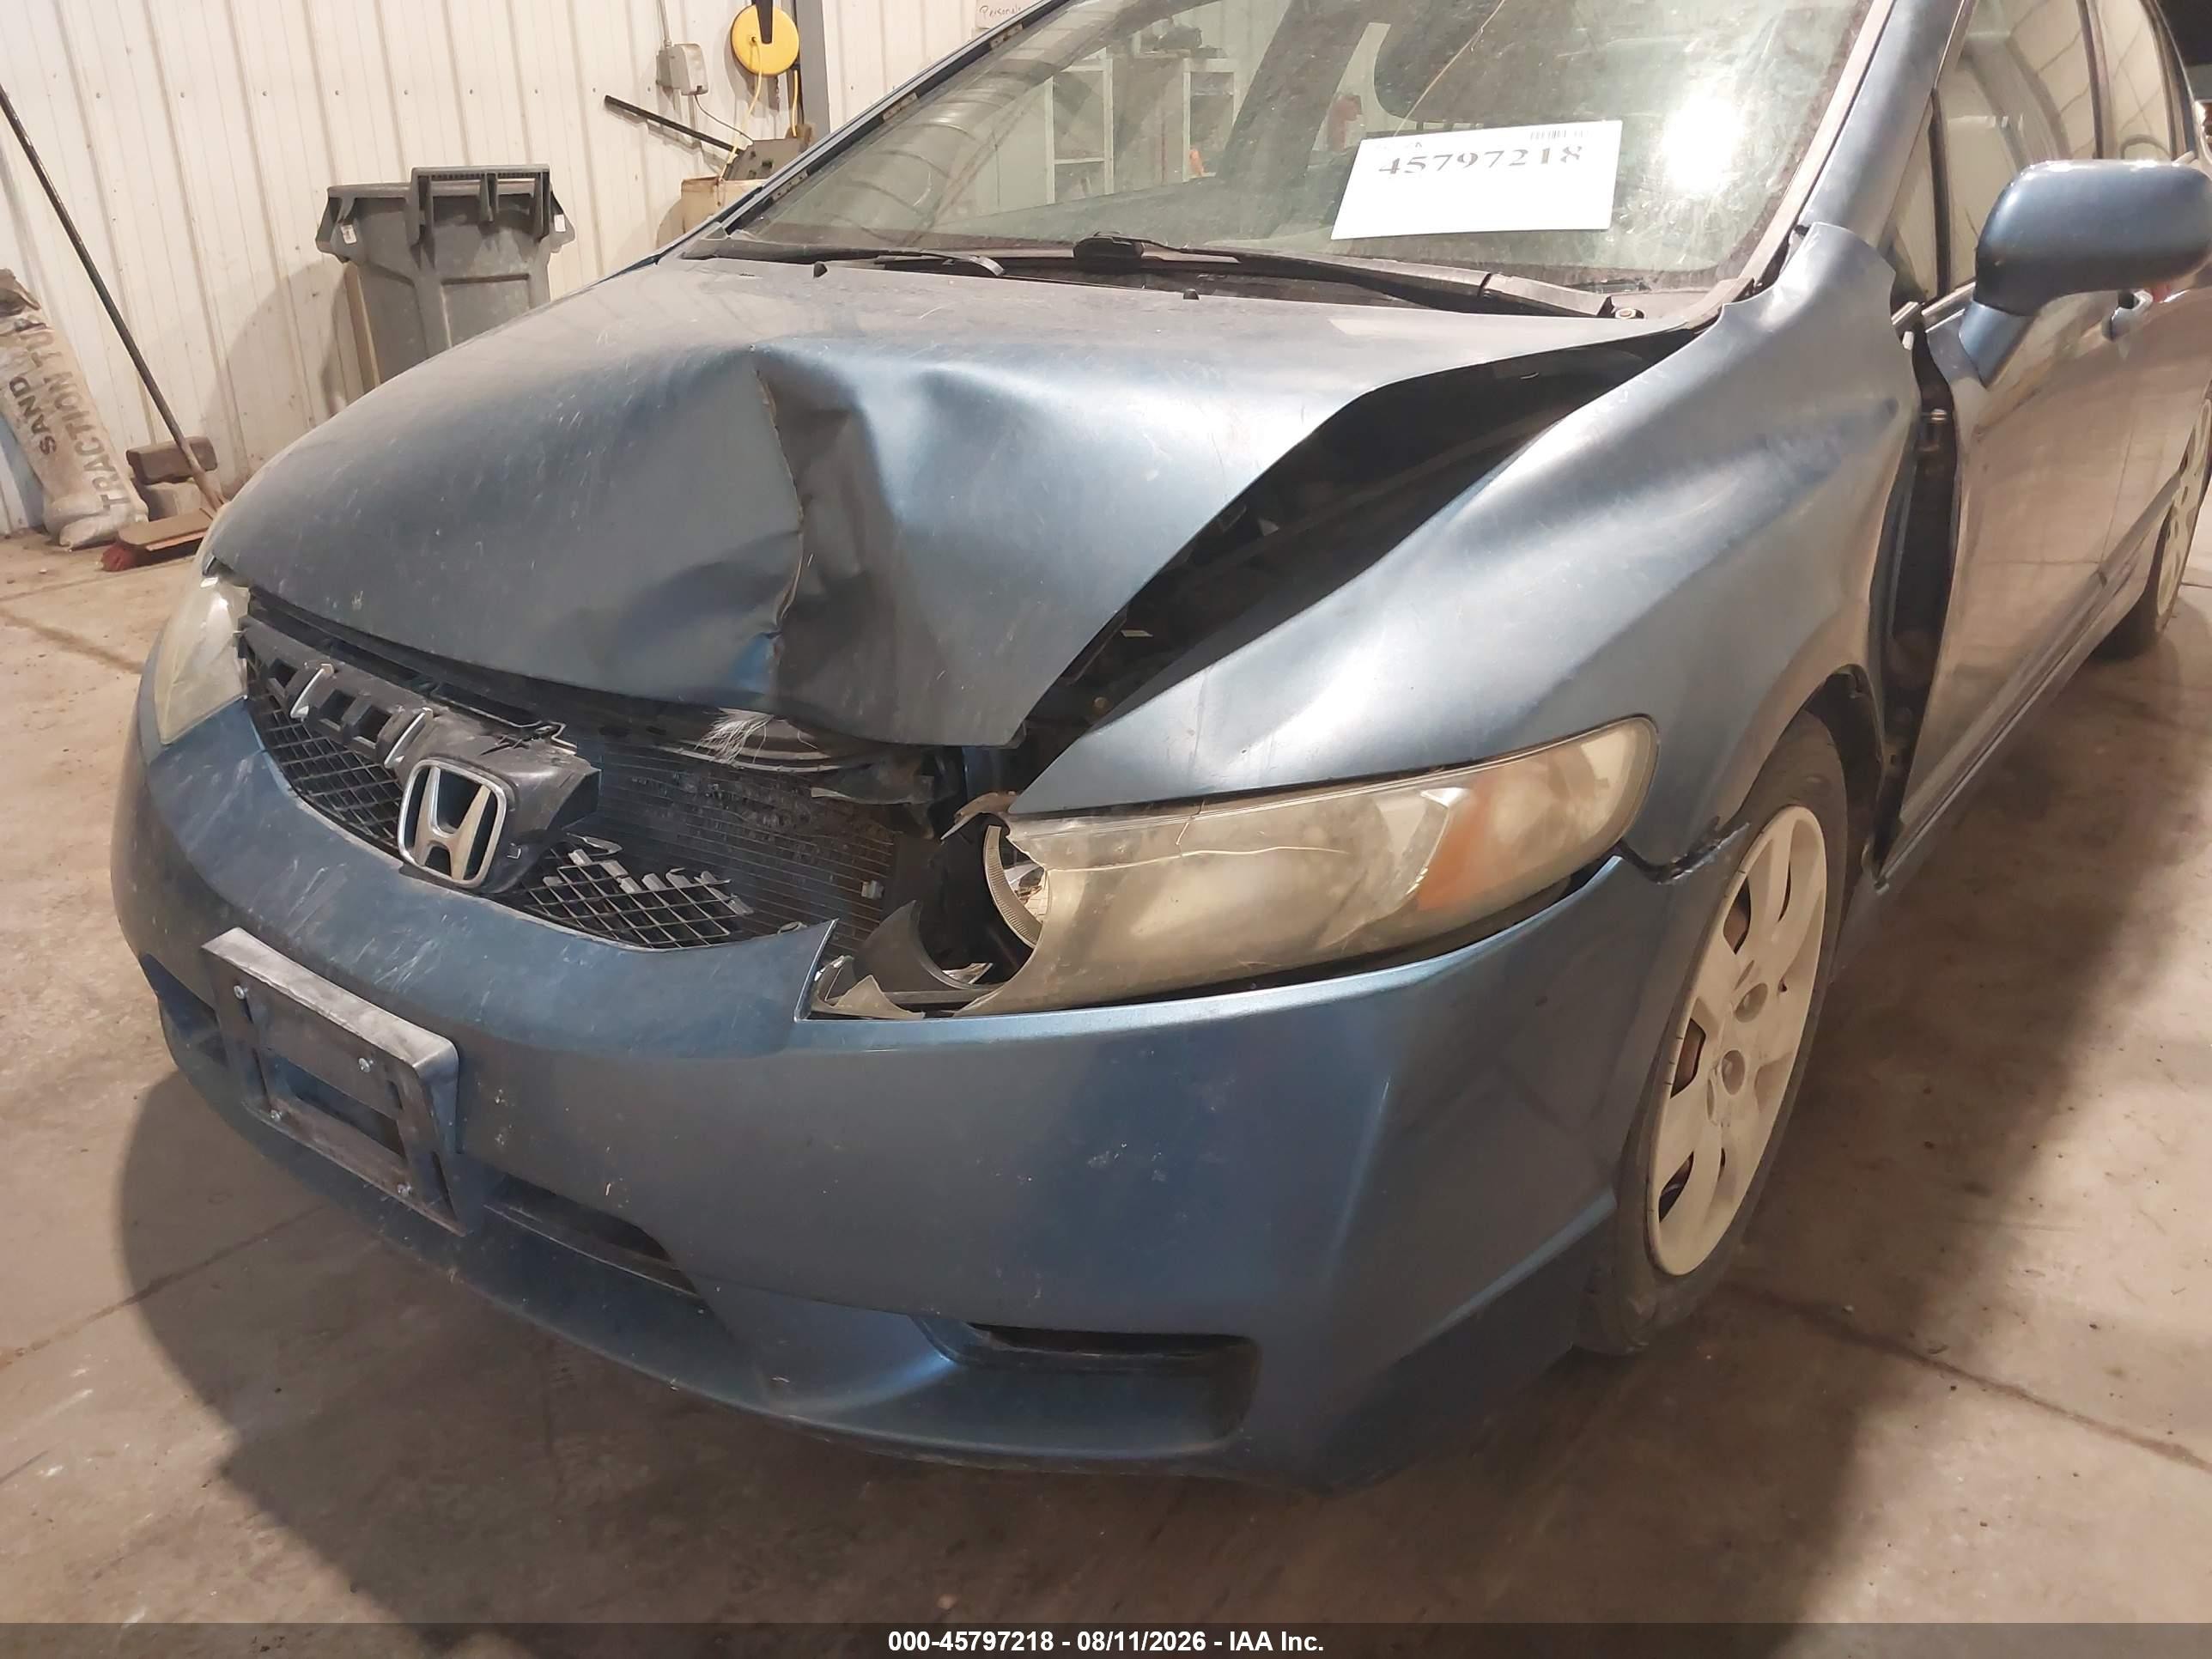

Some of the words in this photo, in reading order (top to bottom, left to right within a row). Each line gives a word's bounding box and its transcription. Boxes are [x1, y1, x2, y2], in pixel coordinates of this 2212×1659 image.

[1377, 144, 1583, 175] 45797218
[9, 376, 58, 456] SAND
[44, 370, 131, 512] TRACTION
